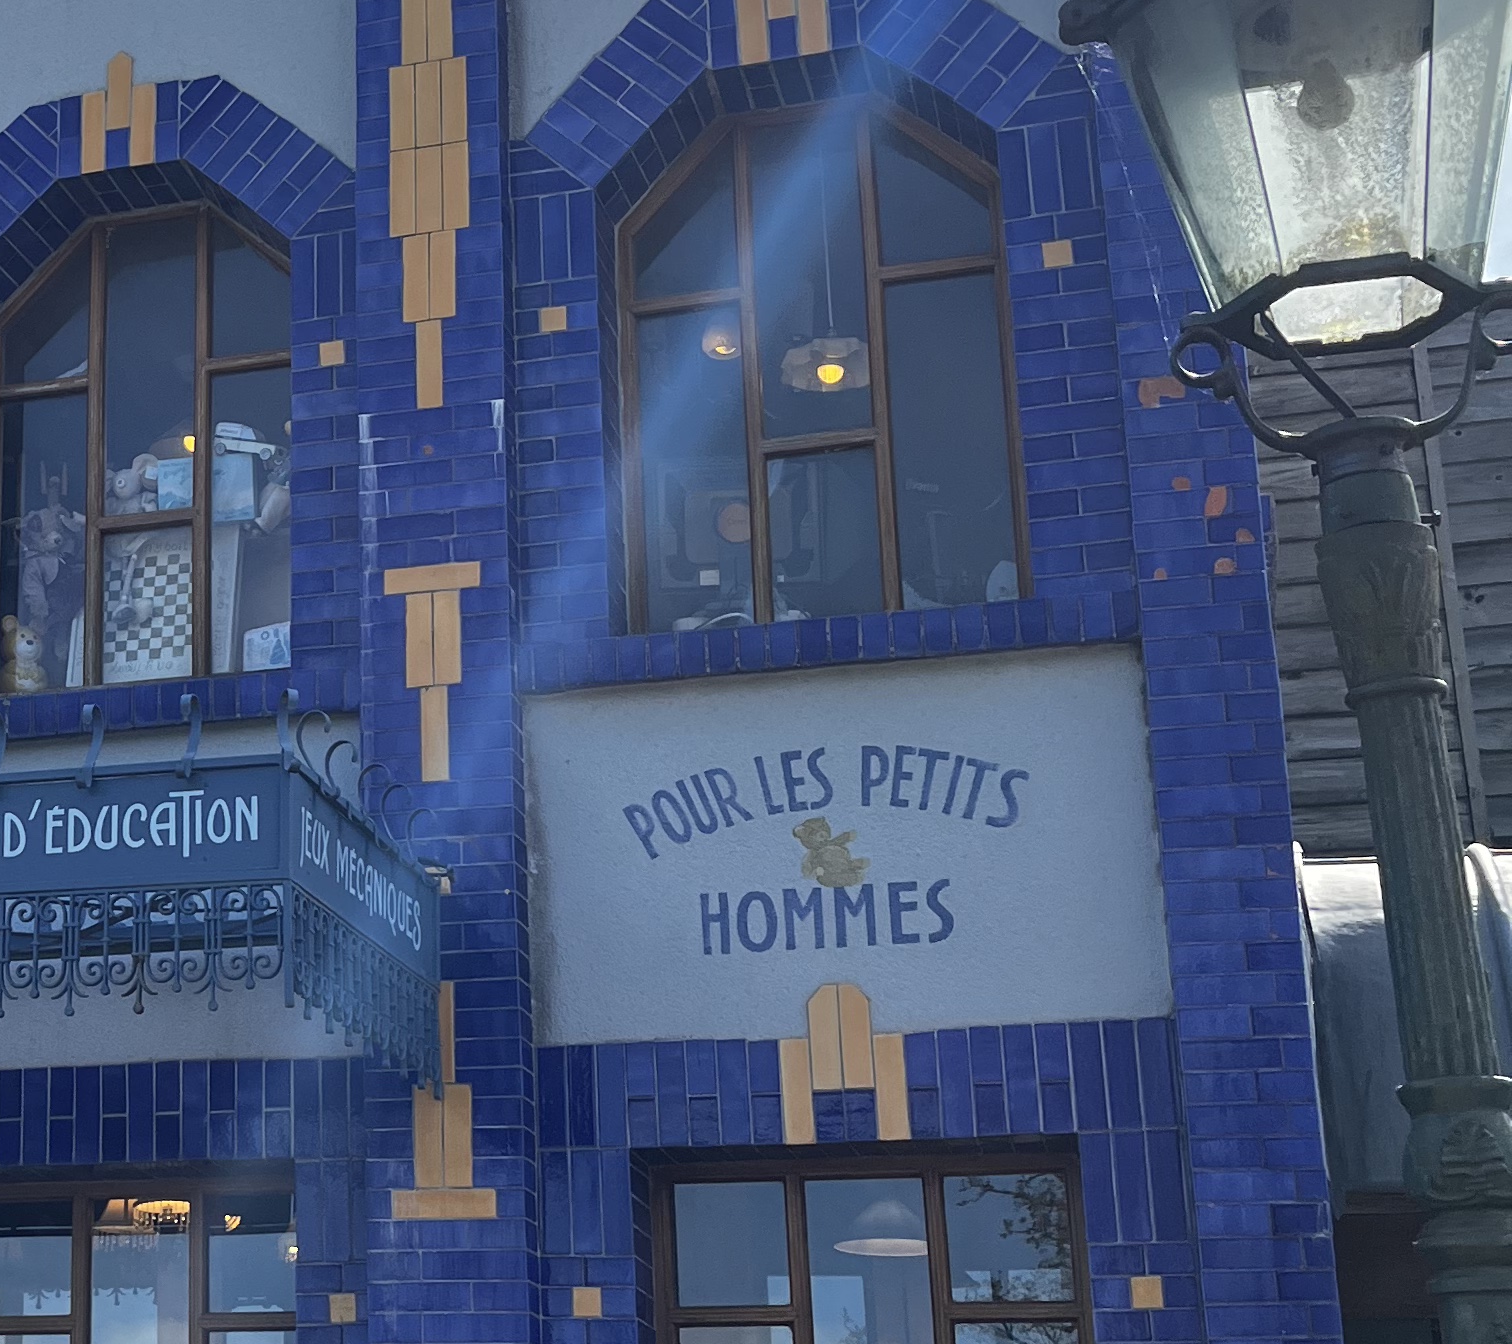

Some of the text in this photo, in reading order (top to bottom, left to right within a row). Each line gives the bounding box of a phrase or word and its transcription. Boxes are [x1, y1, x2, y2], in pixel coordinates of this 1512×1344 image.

[3, 789, 258, 858] D'ÉDUCATION
[621, 744, 1030, 861] POUR LES PETITS
[299, 806, 422, 951] JEUX MÉCANIQUES
[699, 878, 955, 956] HOMMES
